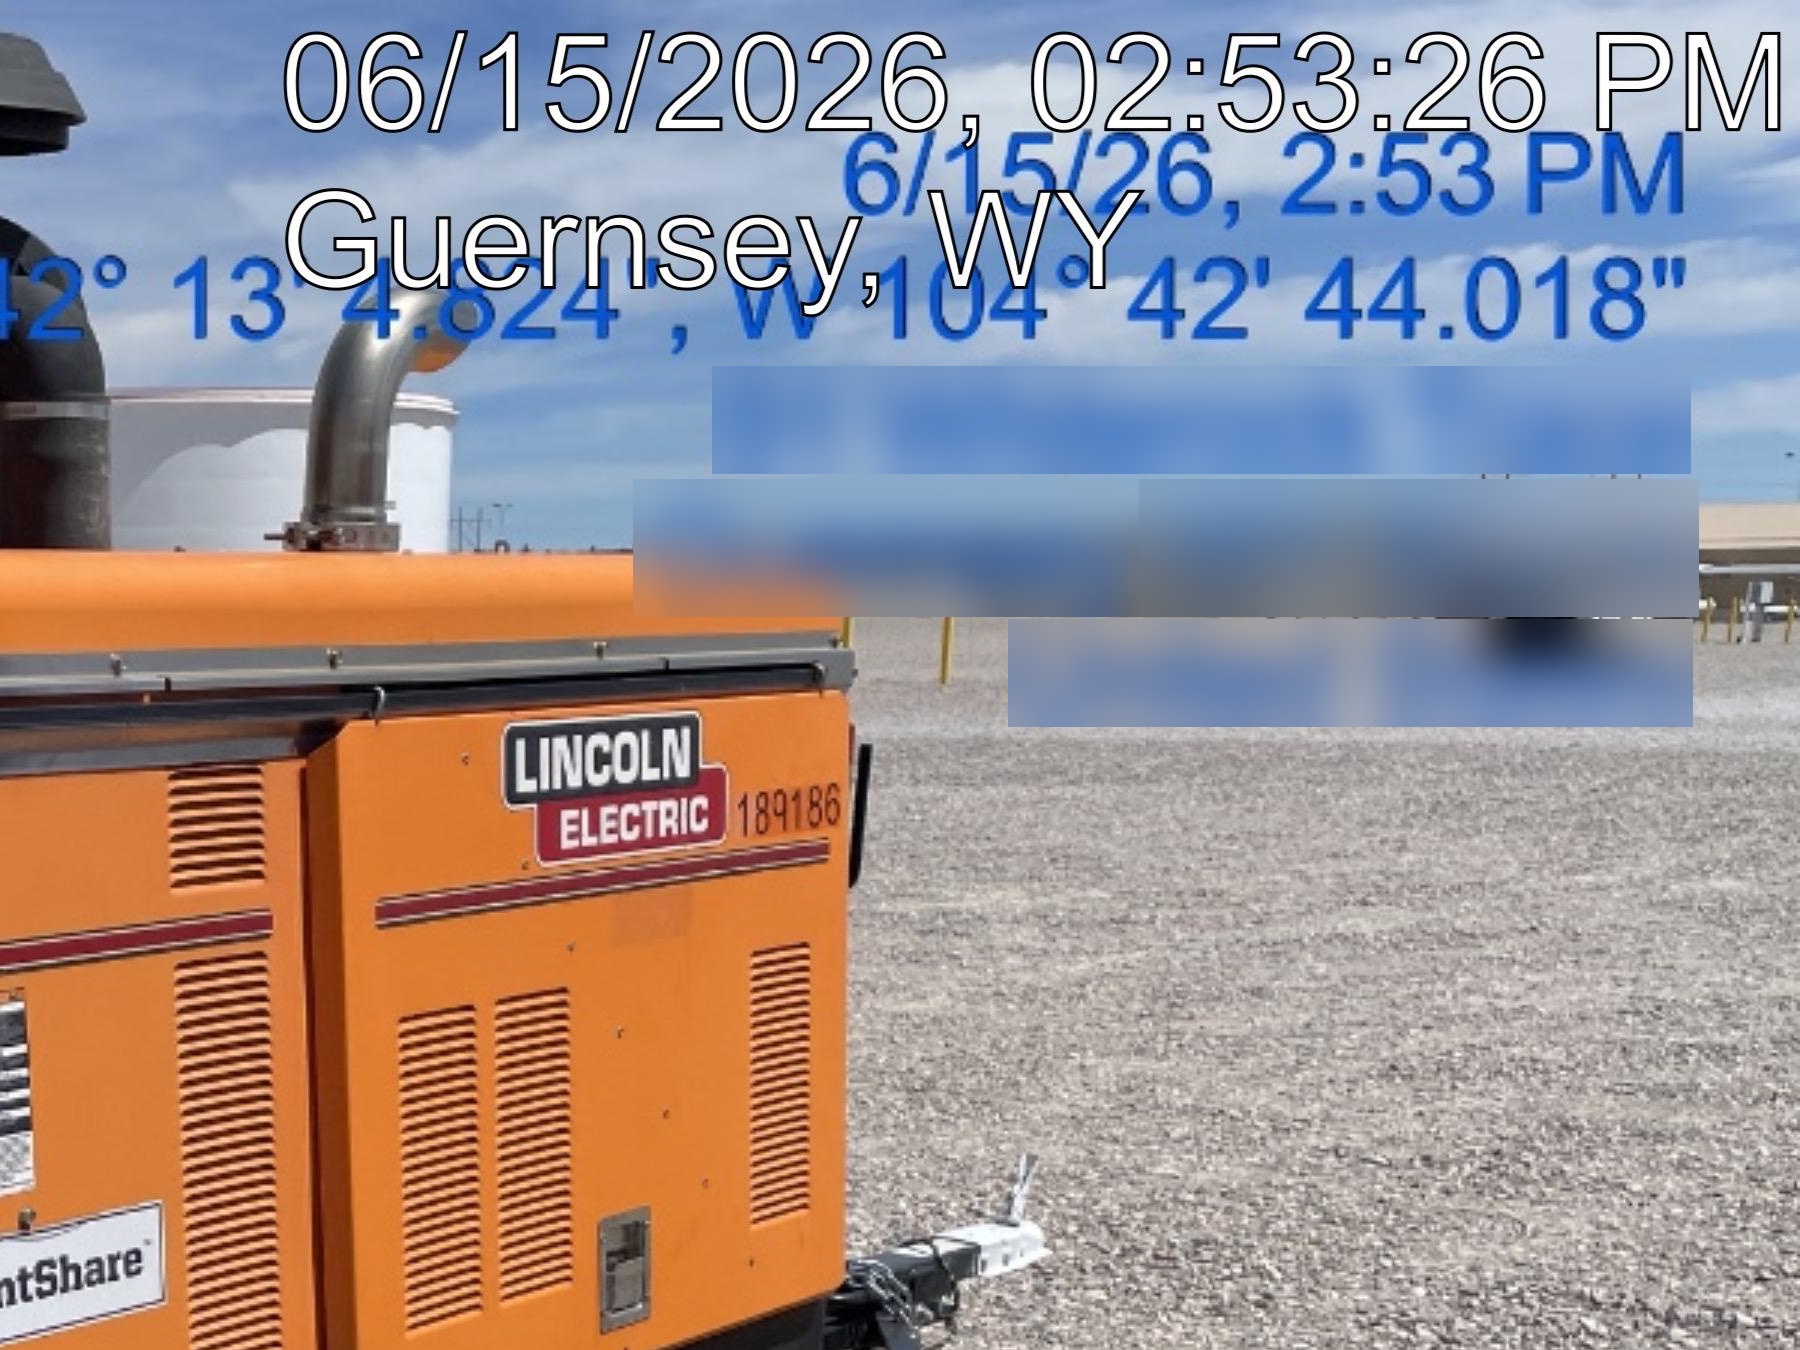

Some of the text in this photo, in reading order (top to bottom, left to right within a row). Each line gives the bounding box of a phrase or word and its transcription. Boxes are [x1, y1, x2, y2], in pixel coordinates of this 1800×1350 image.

[515, 726, 692, 793] LINCOLN
[560, 796, 709, 849] ELECTRIC
[737, 783, 842, 837] 189186
